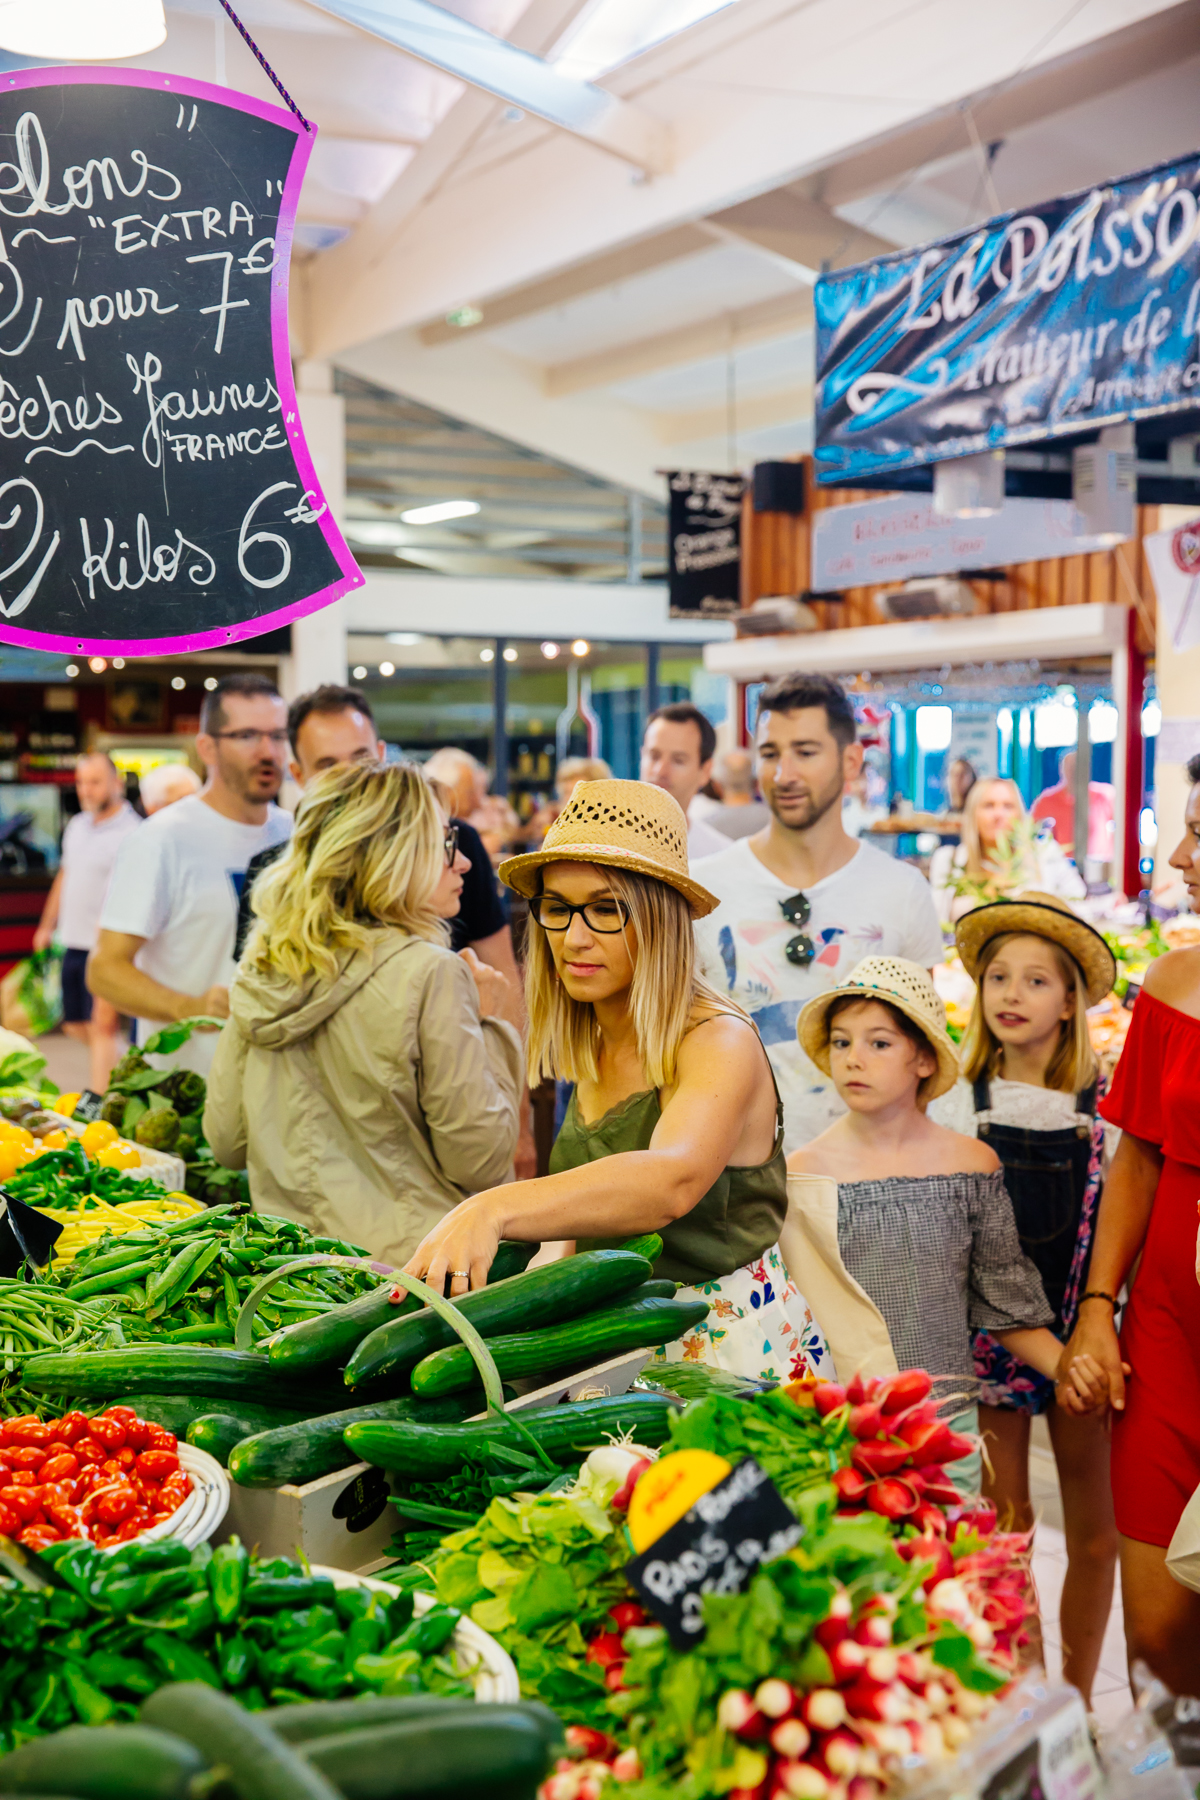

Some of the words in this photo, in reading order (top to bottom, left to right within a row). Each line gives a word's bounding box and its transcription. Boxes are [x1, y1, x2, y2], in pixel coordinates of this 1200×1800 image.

[57, 287, 179, 361] pour
[900, 248, 980, 331] La
[1122, 288, 1173, 354] de
[80, 513, 216, 599] Kilos
